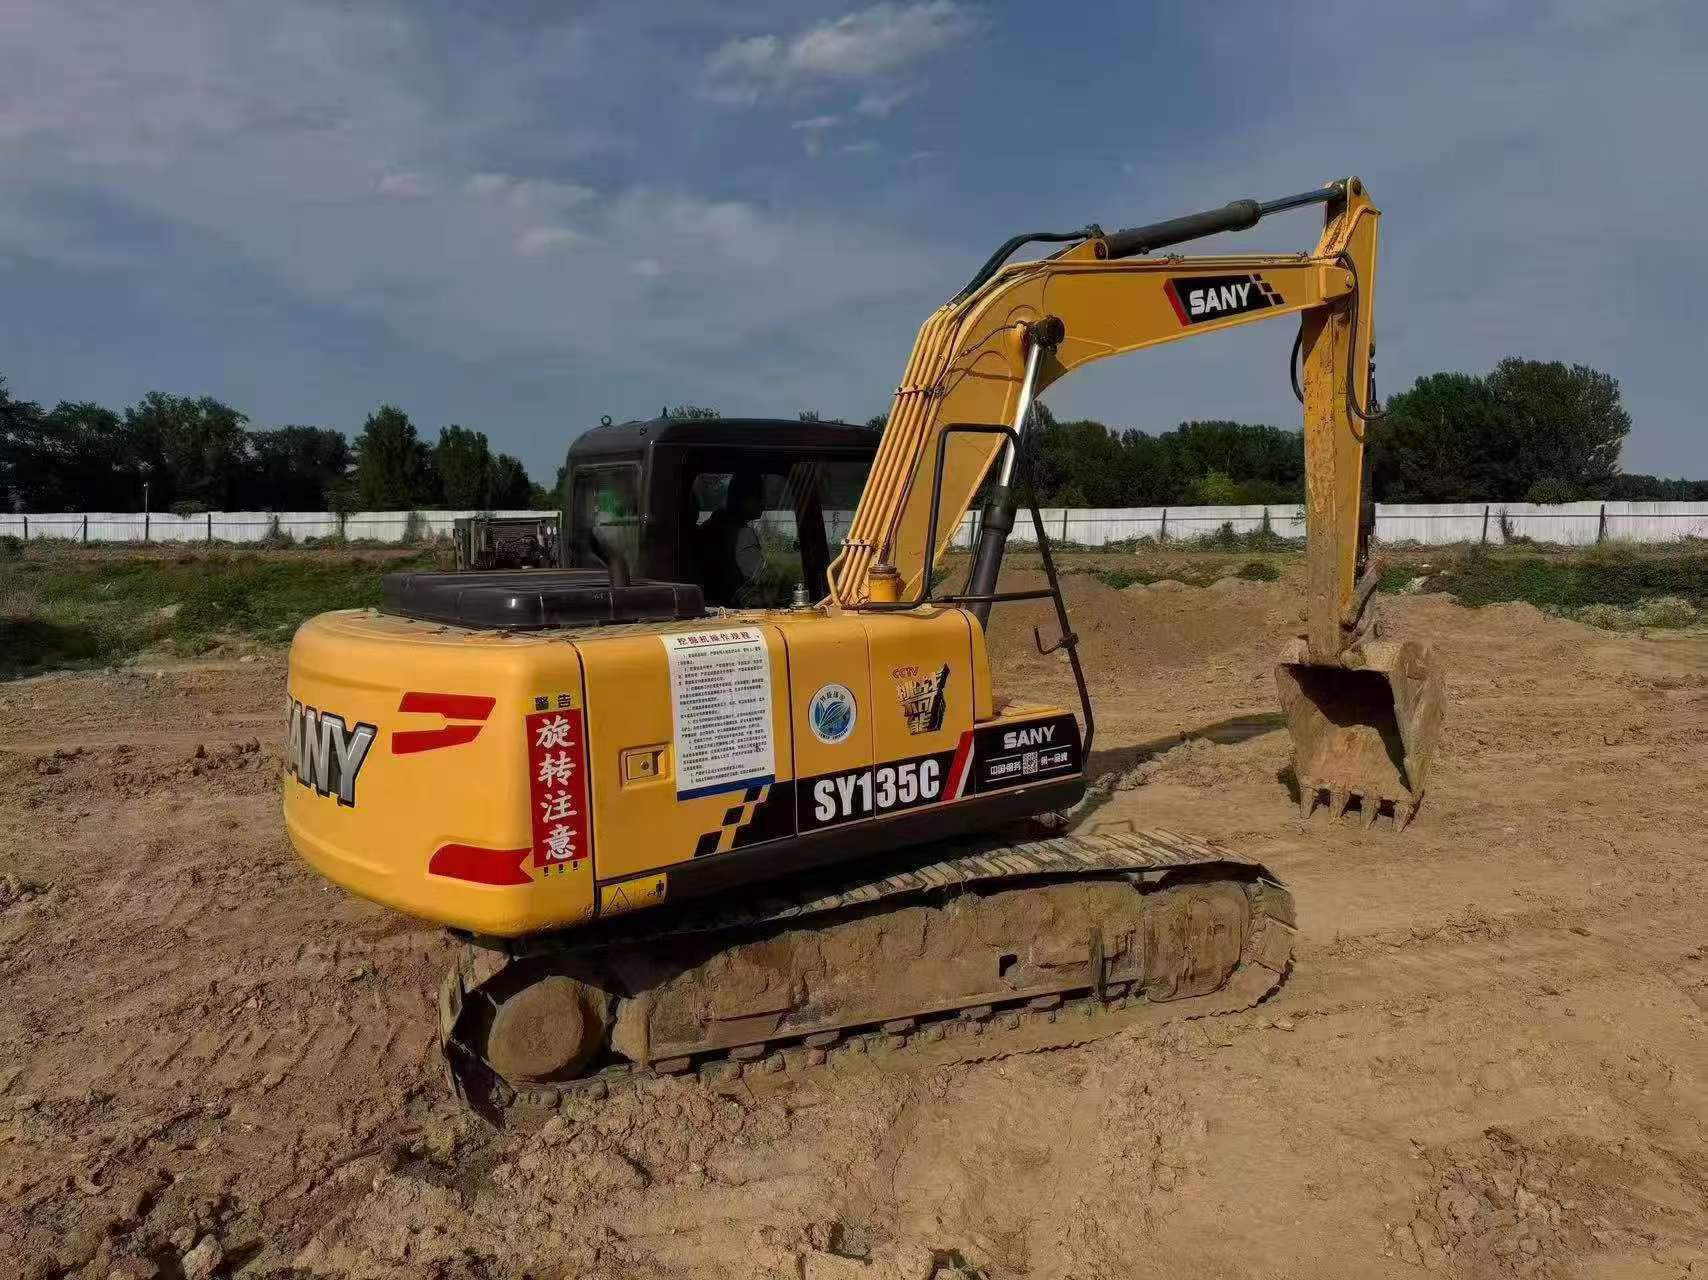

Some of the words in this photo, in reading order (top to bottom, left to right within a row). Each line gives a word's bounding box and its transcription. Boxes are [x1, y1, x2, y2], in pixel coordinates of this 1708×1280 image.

[1189, 283, 1252, 316] SANY
[535, 694, 571, 711] 警告
[288, 695, 379, 808] ANY
[1003, 725, 1056, 750] SANY
[536, 715, 577, 861] 旋转注意
[813, 759, 940, 822] SY135C
